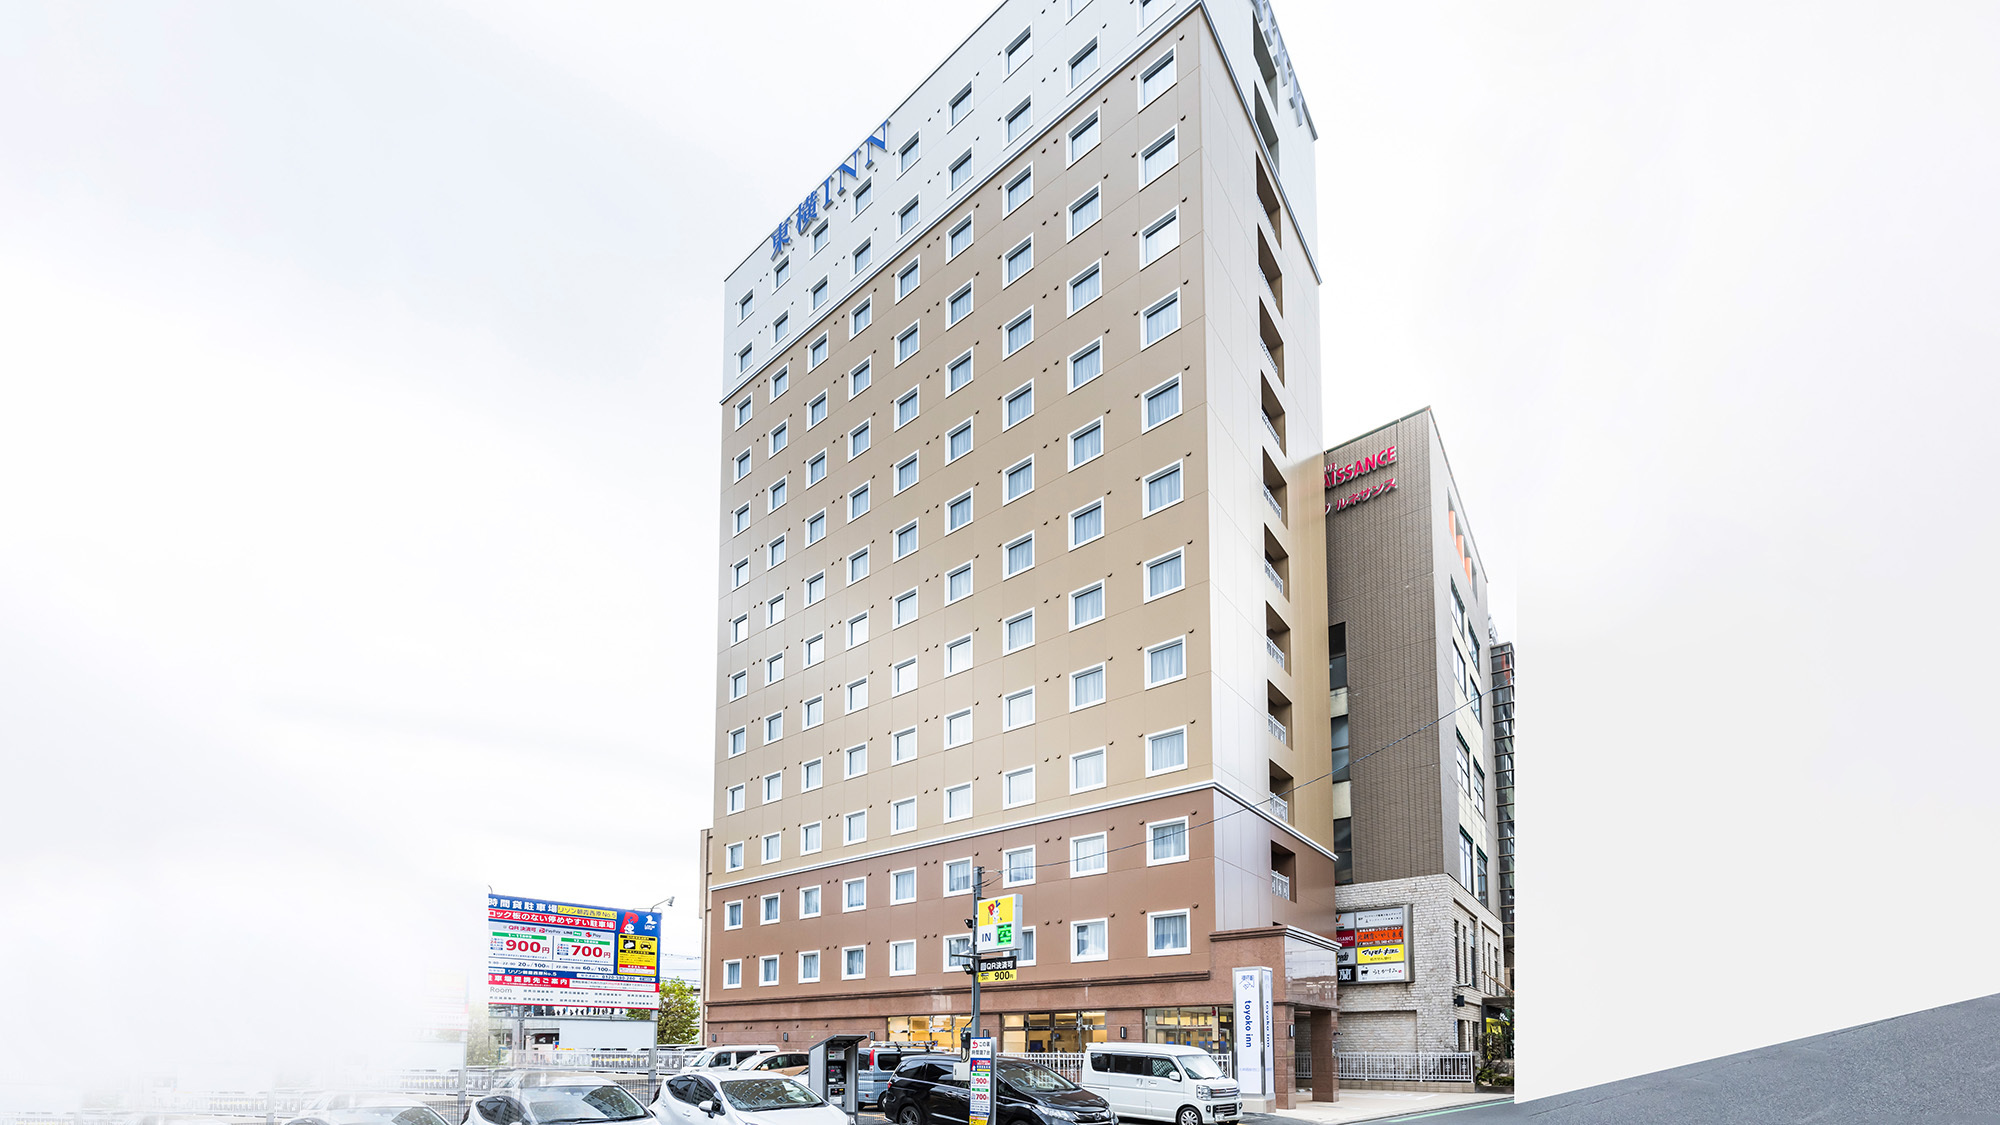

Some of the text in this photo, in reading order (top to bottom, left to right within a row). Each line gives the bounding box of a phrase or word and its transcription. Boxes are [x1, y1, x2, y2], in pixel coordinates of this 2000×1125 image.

[770, 119, 890, 261] 東横INN
[1336, 477, 1398, 511] ルネサンス
[506, 940, 550, 954] 900円
[982, 932, 992, 942] IN
[571, 945, 610, 958] 700円
[1244, 1000, 1253, 1032] toyoko
